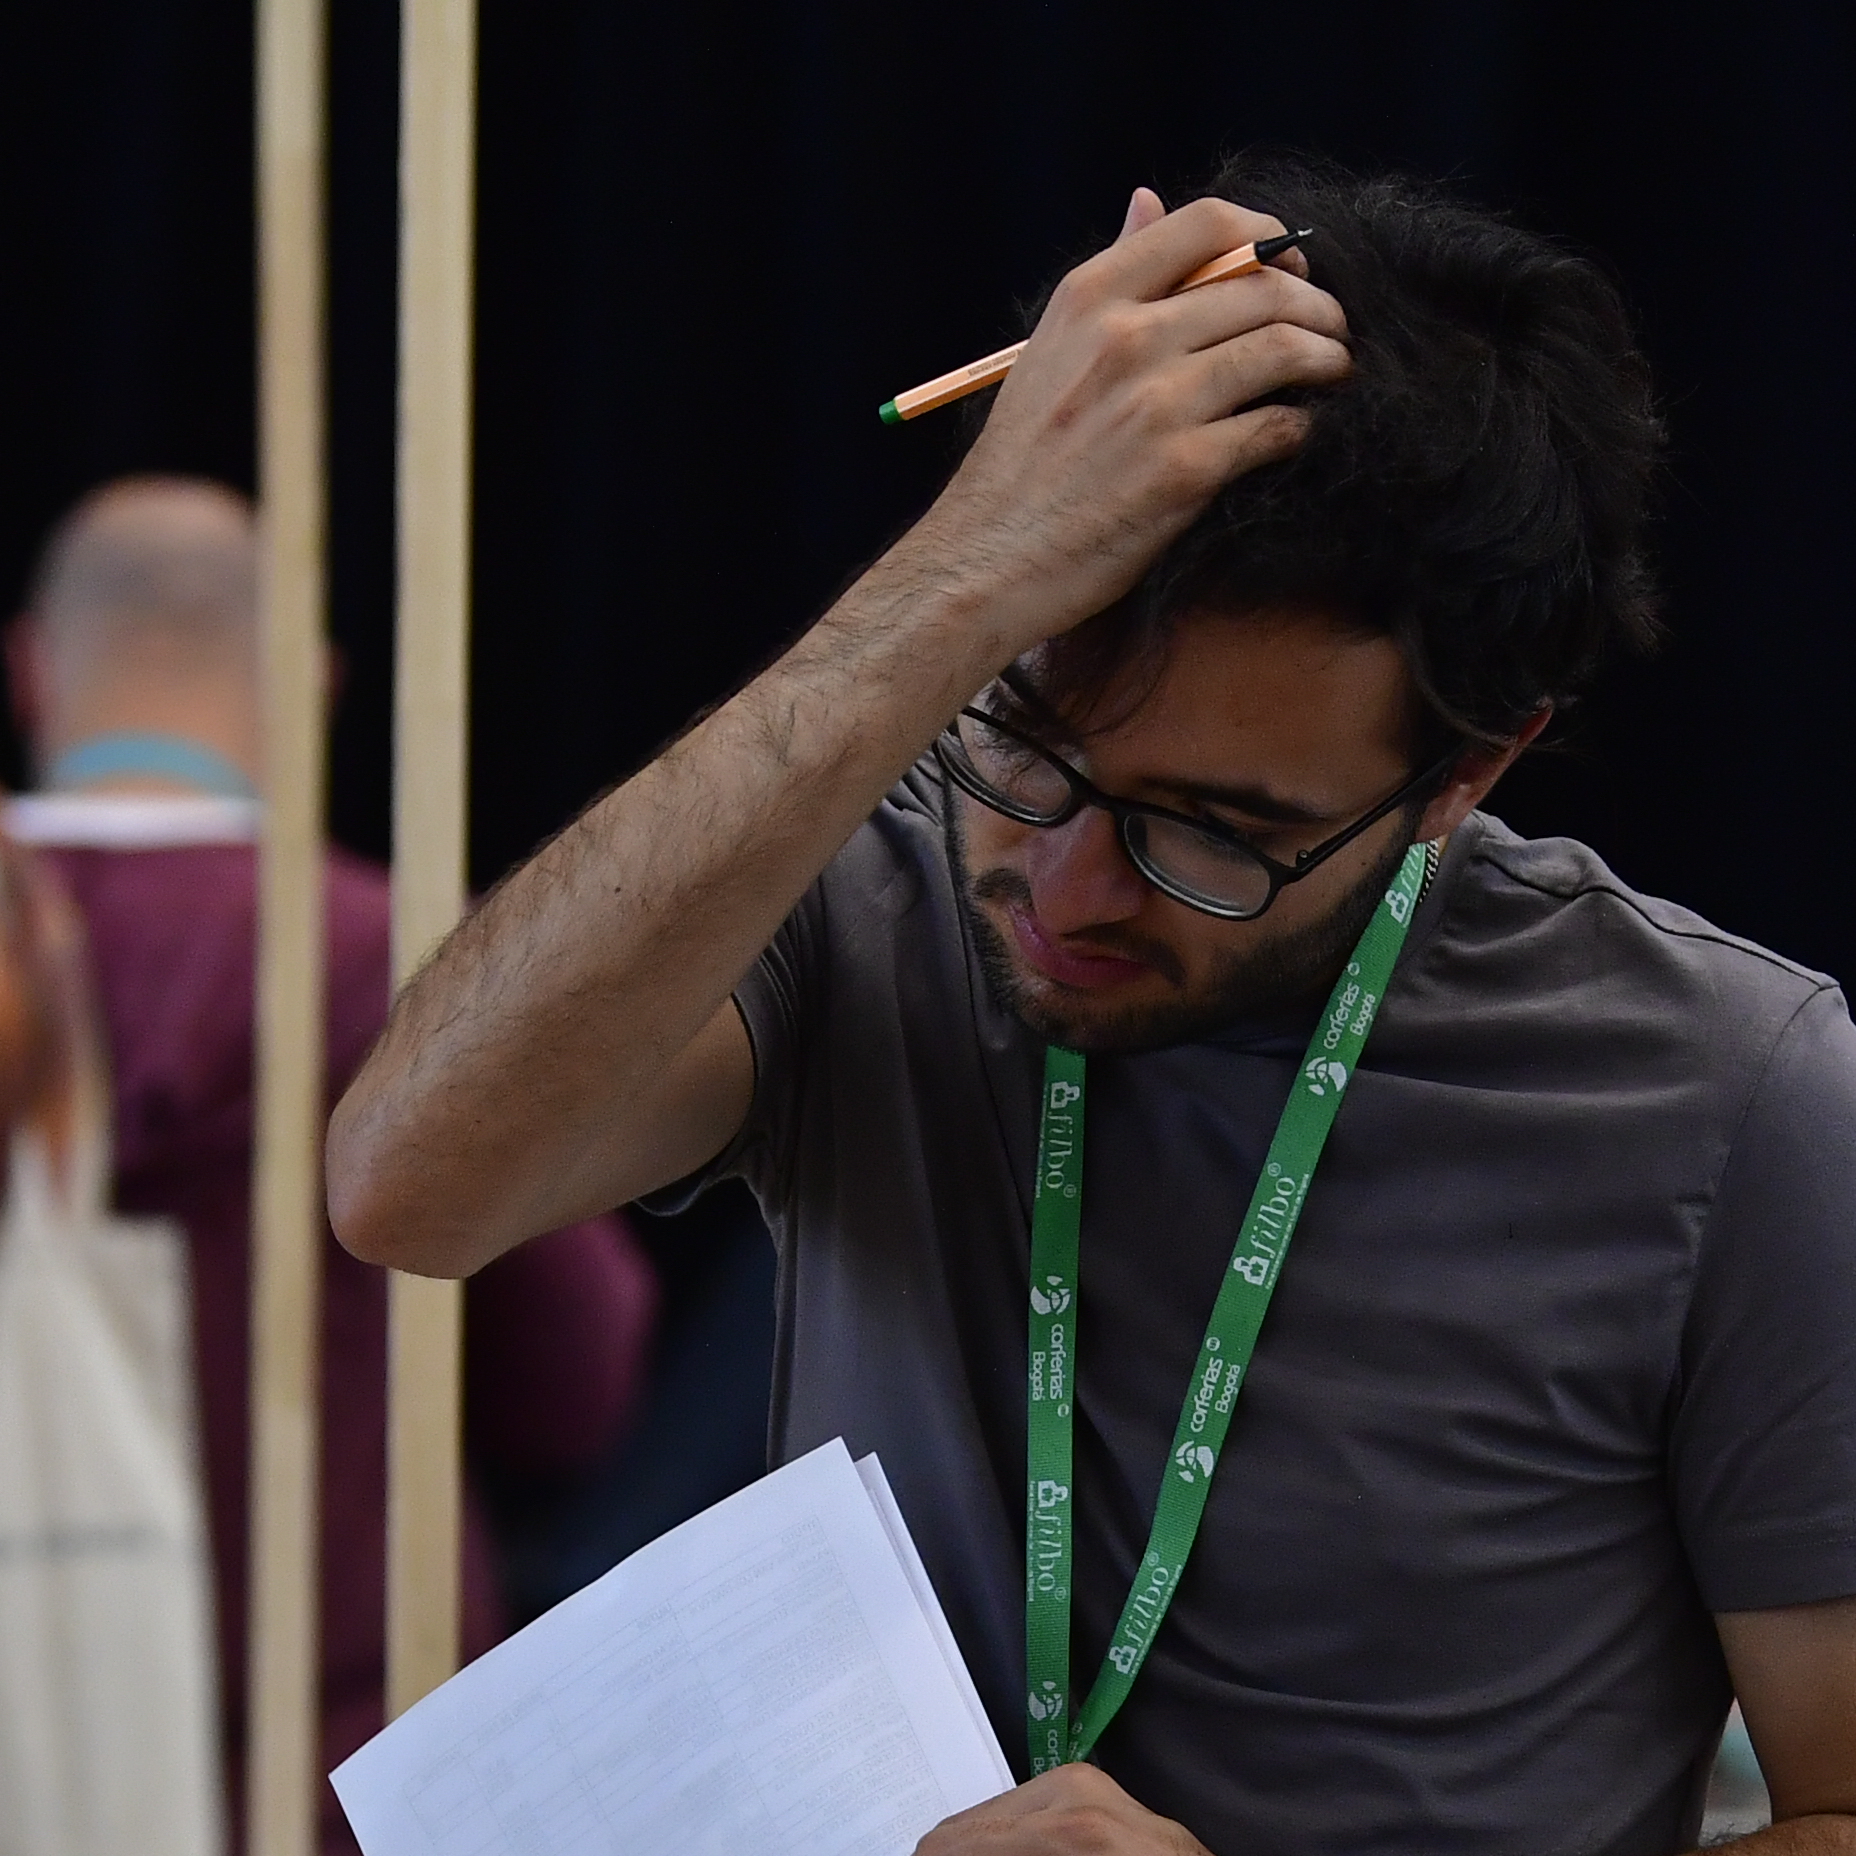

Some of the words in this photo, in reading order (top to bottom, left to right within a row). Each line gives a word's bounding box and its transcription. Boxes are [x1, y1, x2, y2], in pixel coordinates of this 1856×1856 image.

[1323, 982, 1360, 1050] corferias
[1350, 992, 1375, 1036] Bogotá
[1045, 1111, 1073, 1190] filbo
[1250, 1177, 1296, 1259] filbo
[1029, 1351, 1046, 1401] Bogotá
[1050, 1323, 1067, 1400] corferias
[1190, 1356, 1223, 1433] corferias
[1214, 1363, 1240, 1414] Bogotá
[1034, 1510, 1062, 1592] filbo
[1124, 1567, 1170, 1648] filbo
